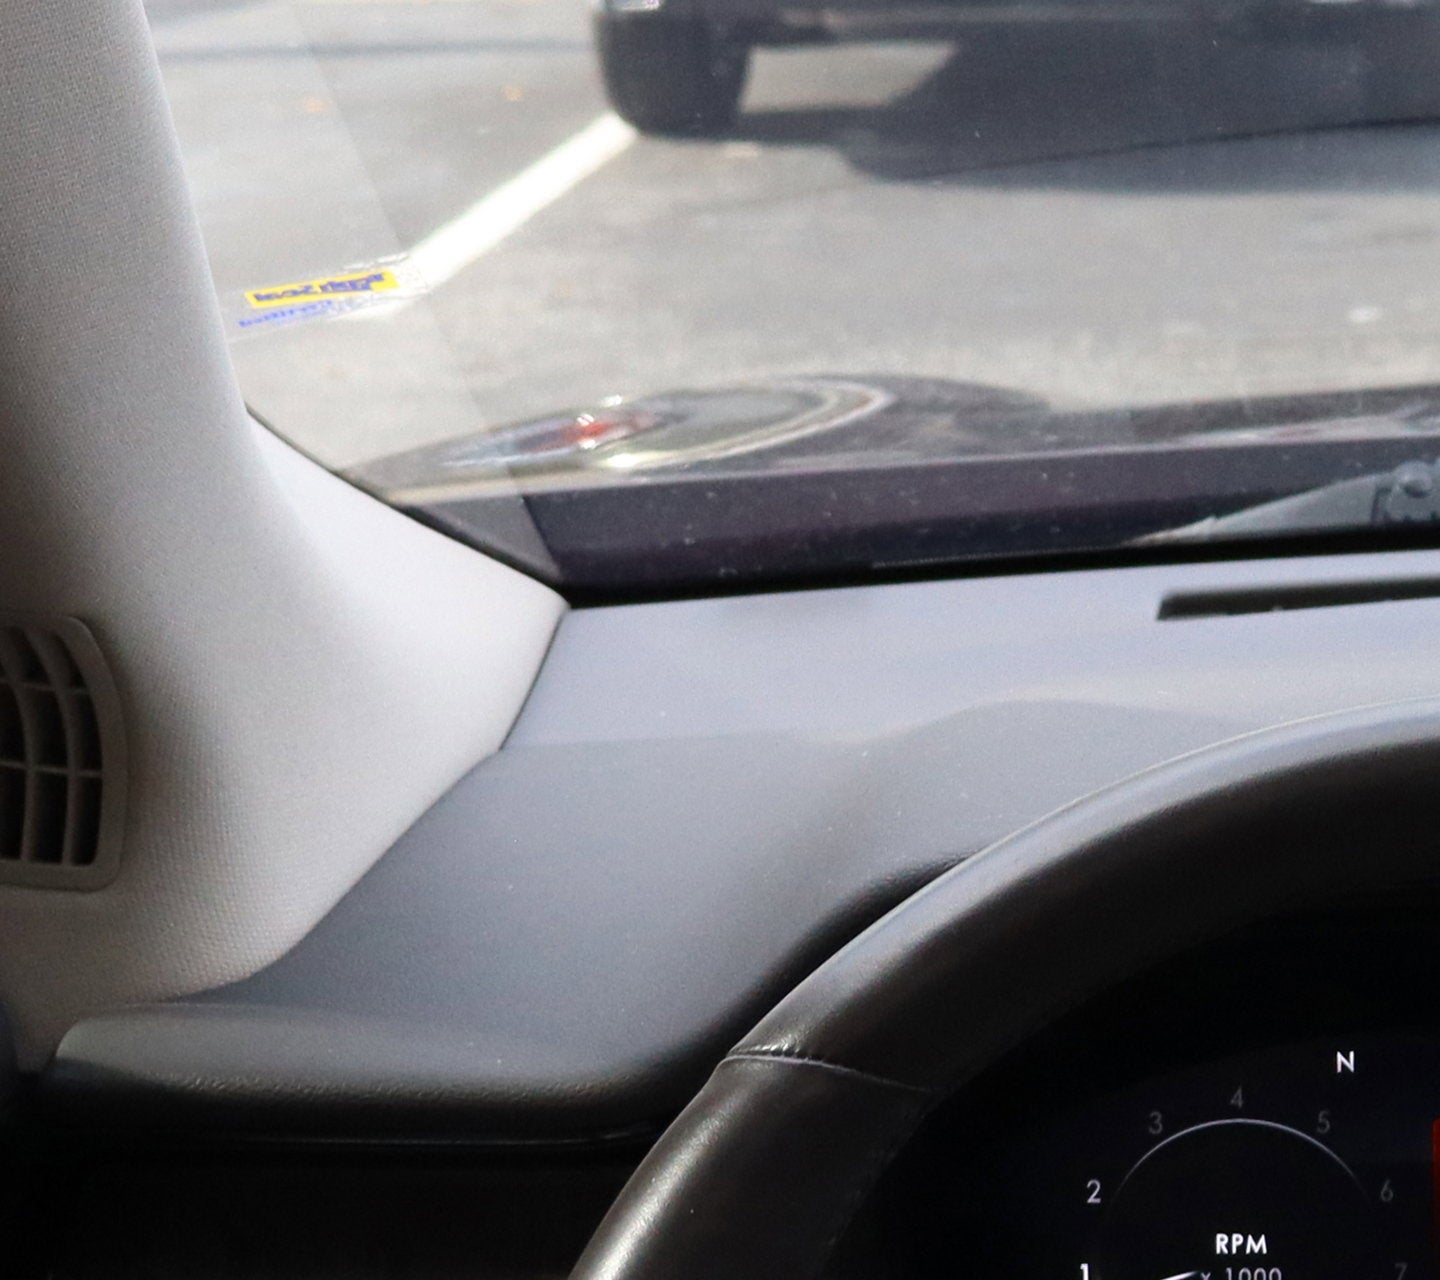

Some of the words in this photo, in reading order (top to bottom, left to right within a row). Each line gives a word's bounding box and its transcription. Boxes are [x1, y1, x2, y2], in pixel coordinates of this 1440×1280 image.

[1336, 1050, 1356, 1073] N
[1229, 1086, 1245, 1108] 4
[1086, 1179, 1103, 1204] 2
[1214, 1233, 1269, 1255] RPM
